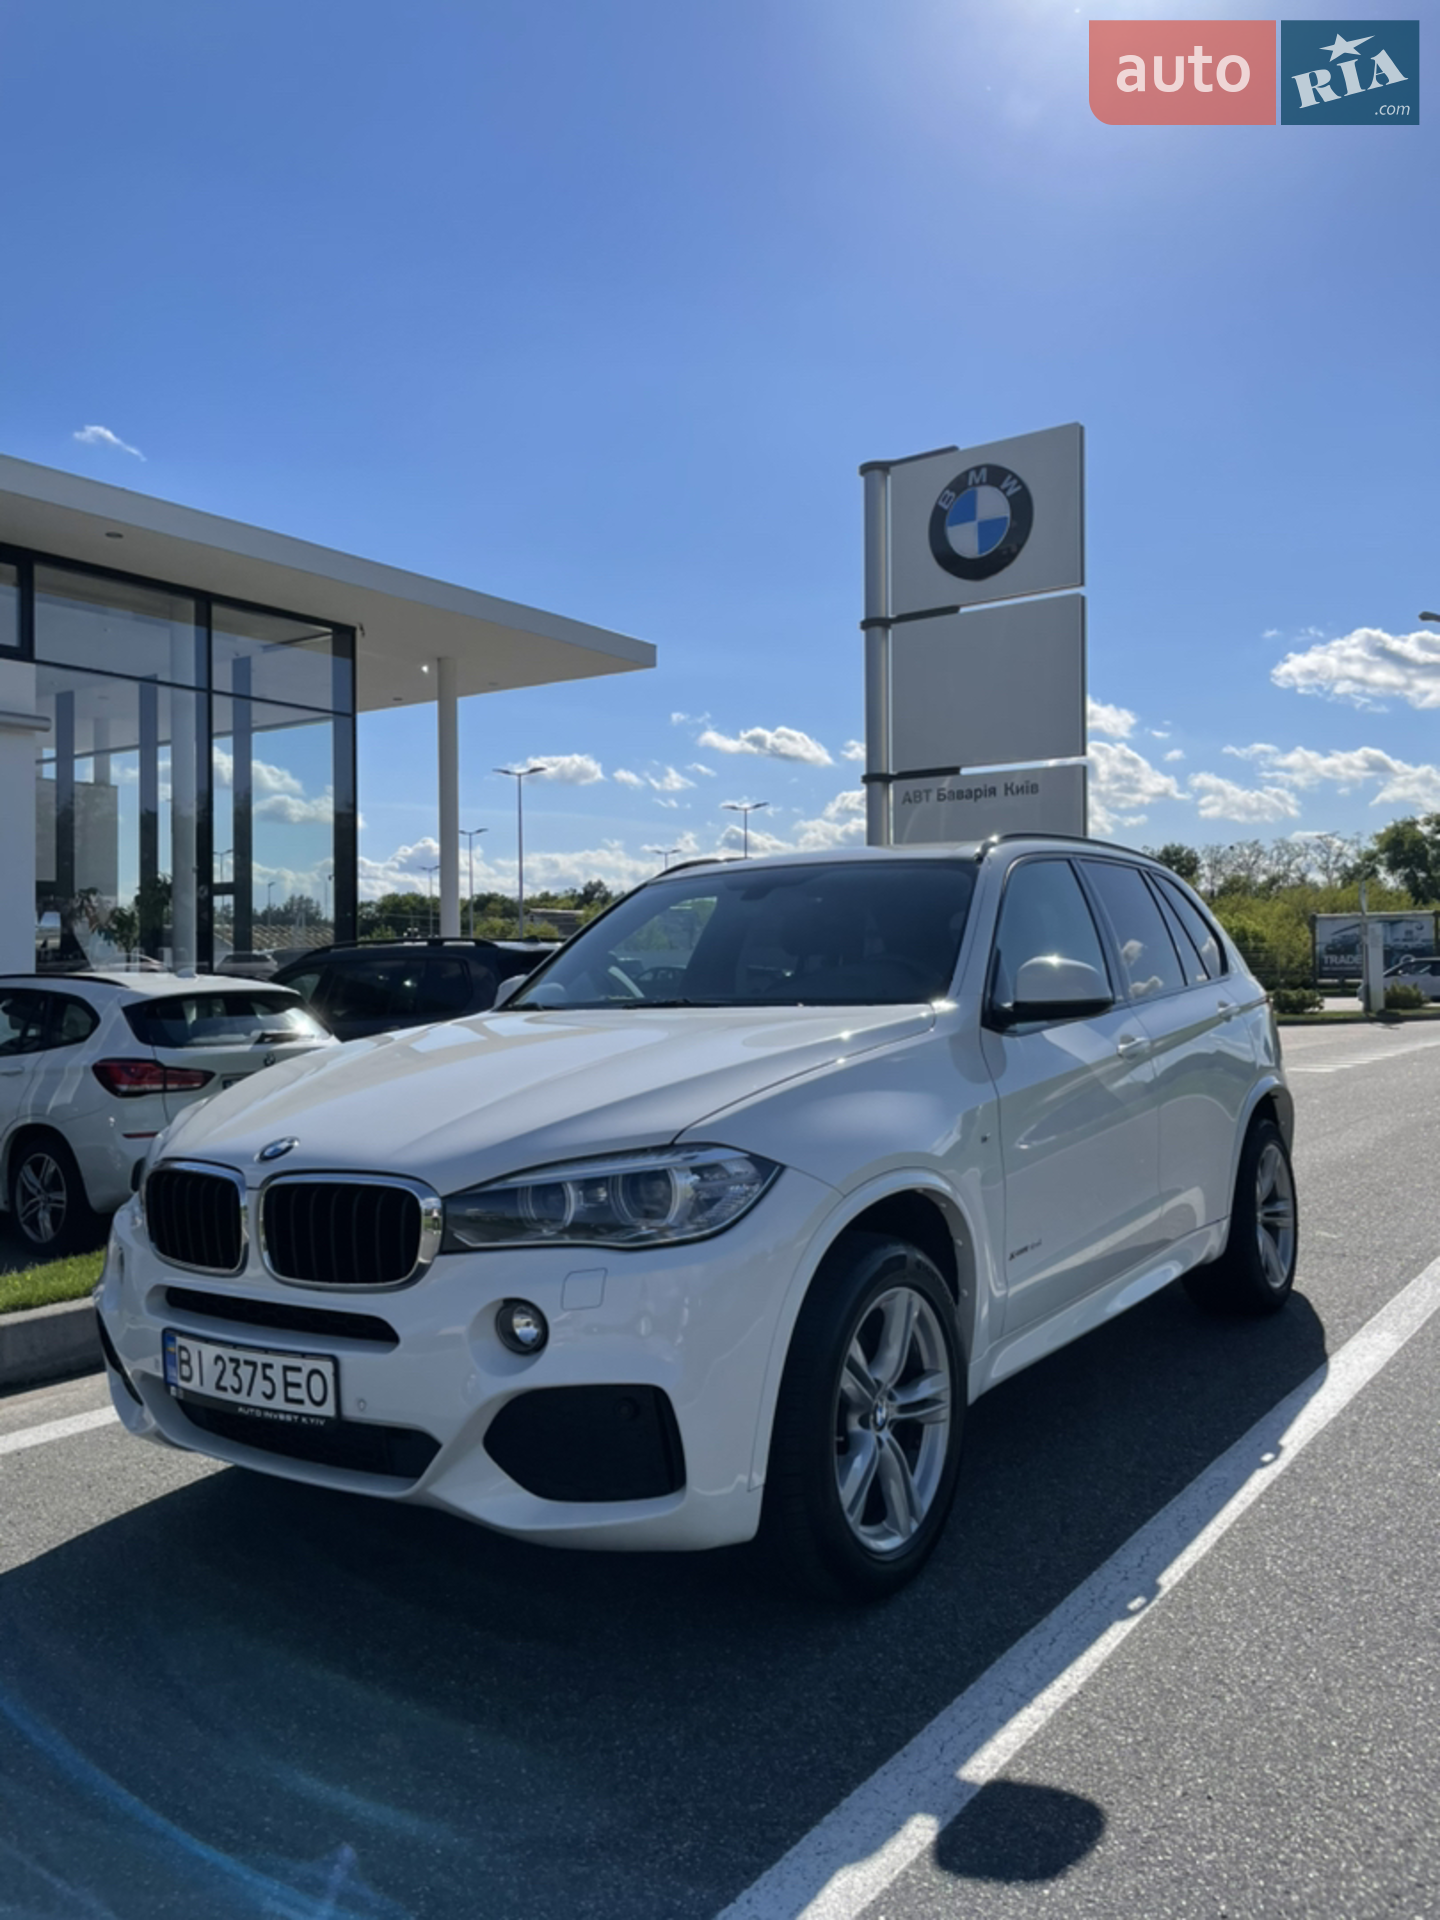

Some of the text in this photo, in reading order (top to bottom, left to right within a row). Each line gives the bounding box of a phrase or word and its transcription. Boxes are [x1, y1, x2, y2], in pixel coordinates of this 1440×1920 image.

[938, 466, 1022, 511] BMW
[936, 783, 997, 803] Баварія
[1003, 780, 1040, 797] Київ
[238, 1406, 262, 1417] AUTO
[301, 1416, 326, 1426] KYIV
